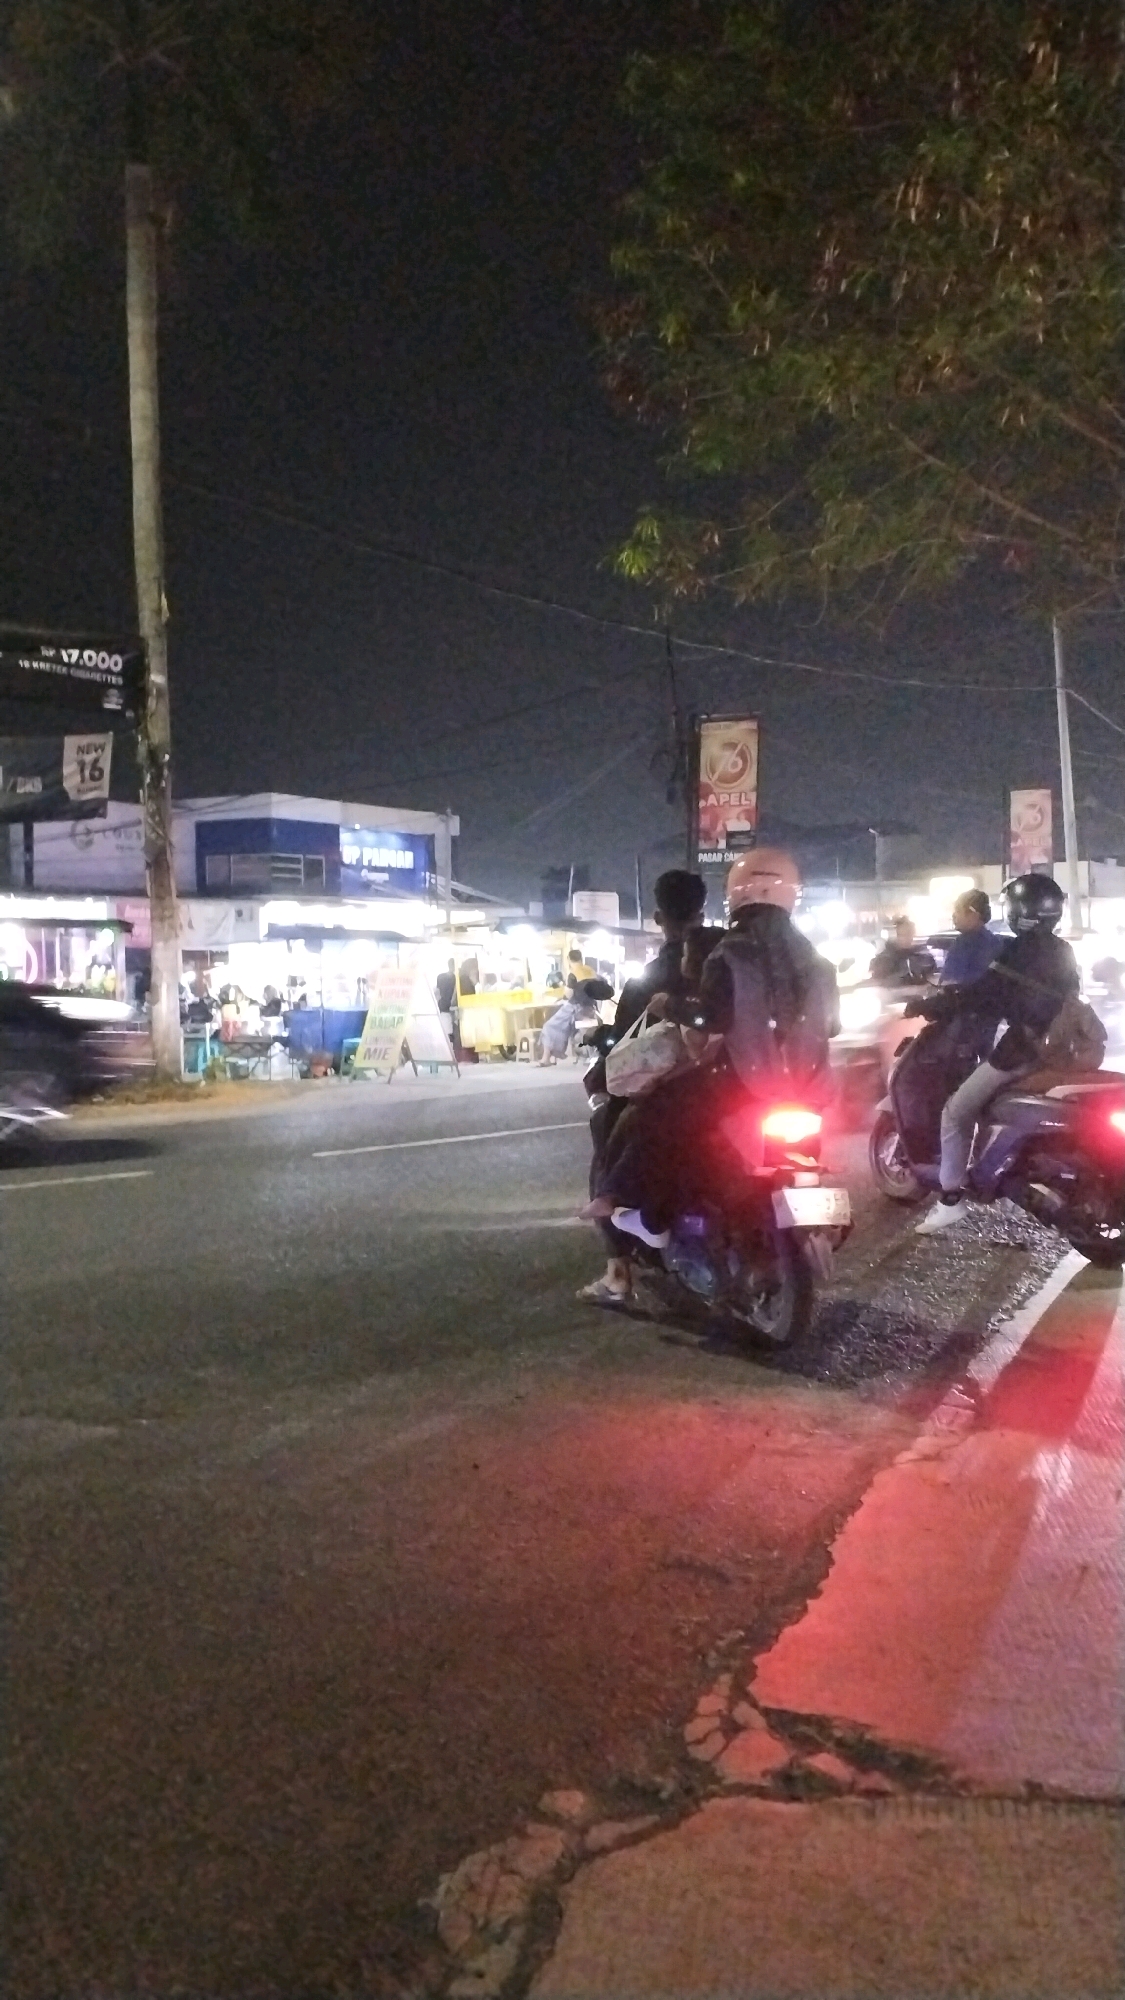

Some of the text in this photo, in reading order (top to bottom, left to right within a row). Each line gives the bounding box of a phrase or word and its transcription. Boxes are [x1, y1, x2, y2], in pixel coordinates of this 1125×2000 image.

[60, 648, 123, 673] 17.000
[76, 742, 107, 756] NEW
[77, 757, 105, 783] 16
[370, 1015, 404, 1029] BALAP
[363, 1047, 393, 1060] MIE
